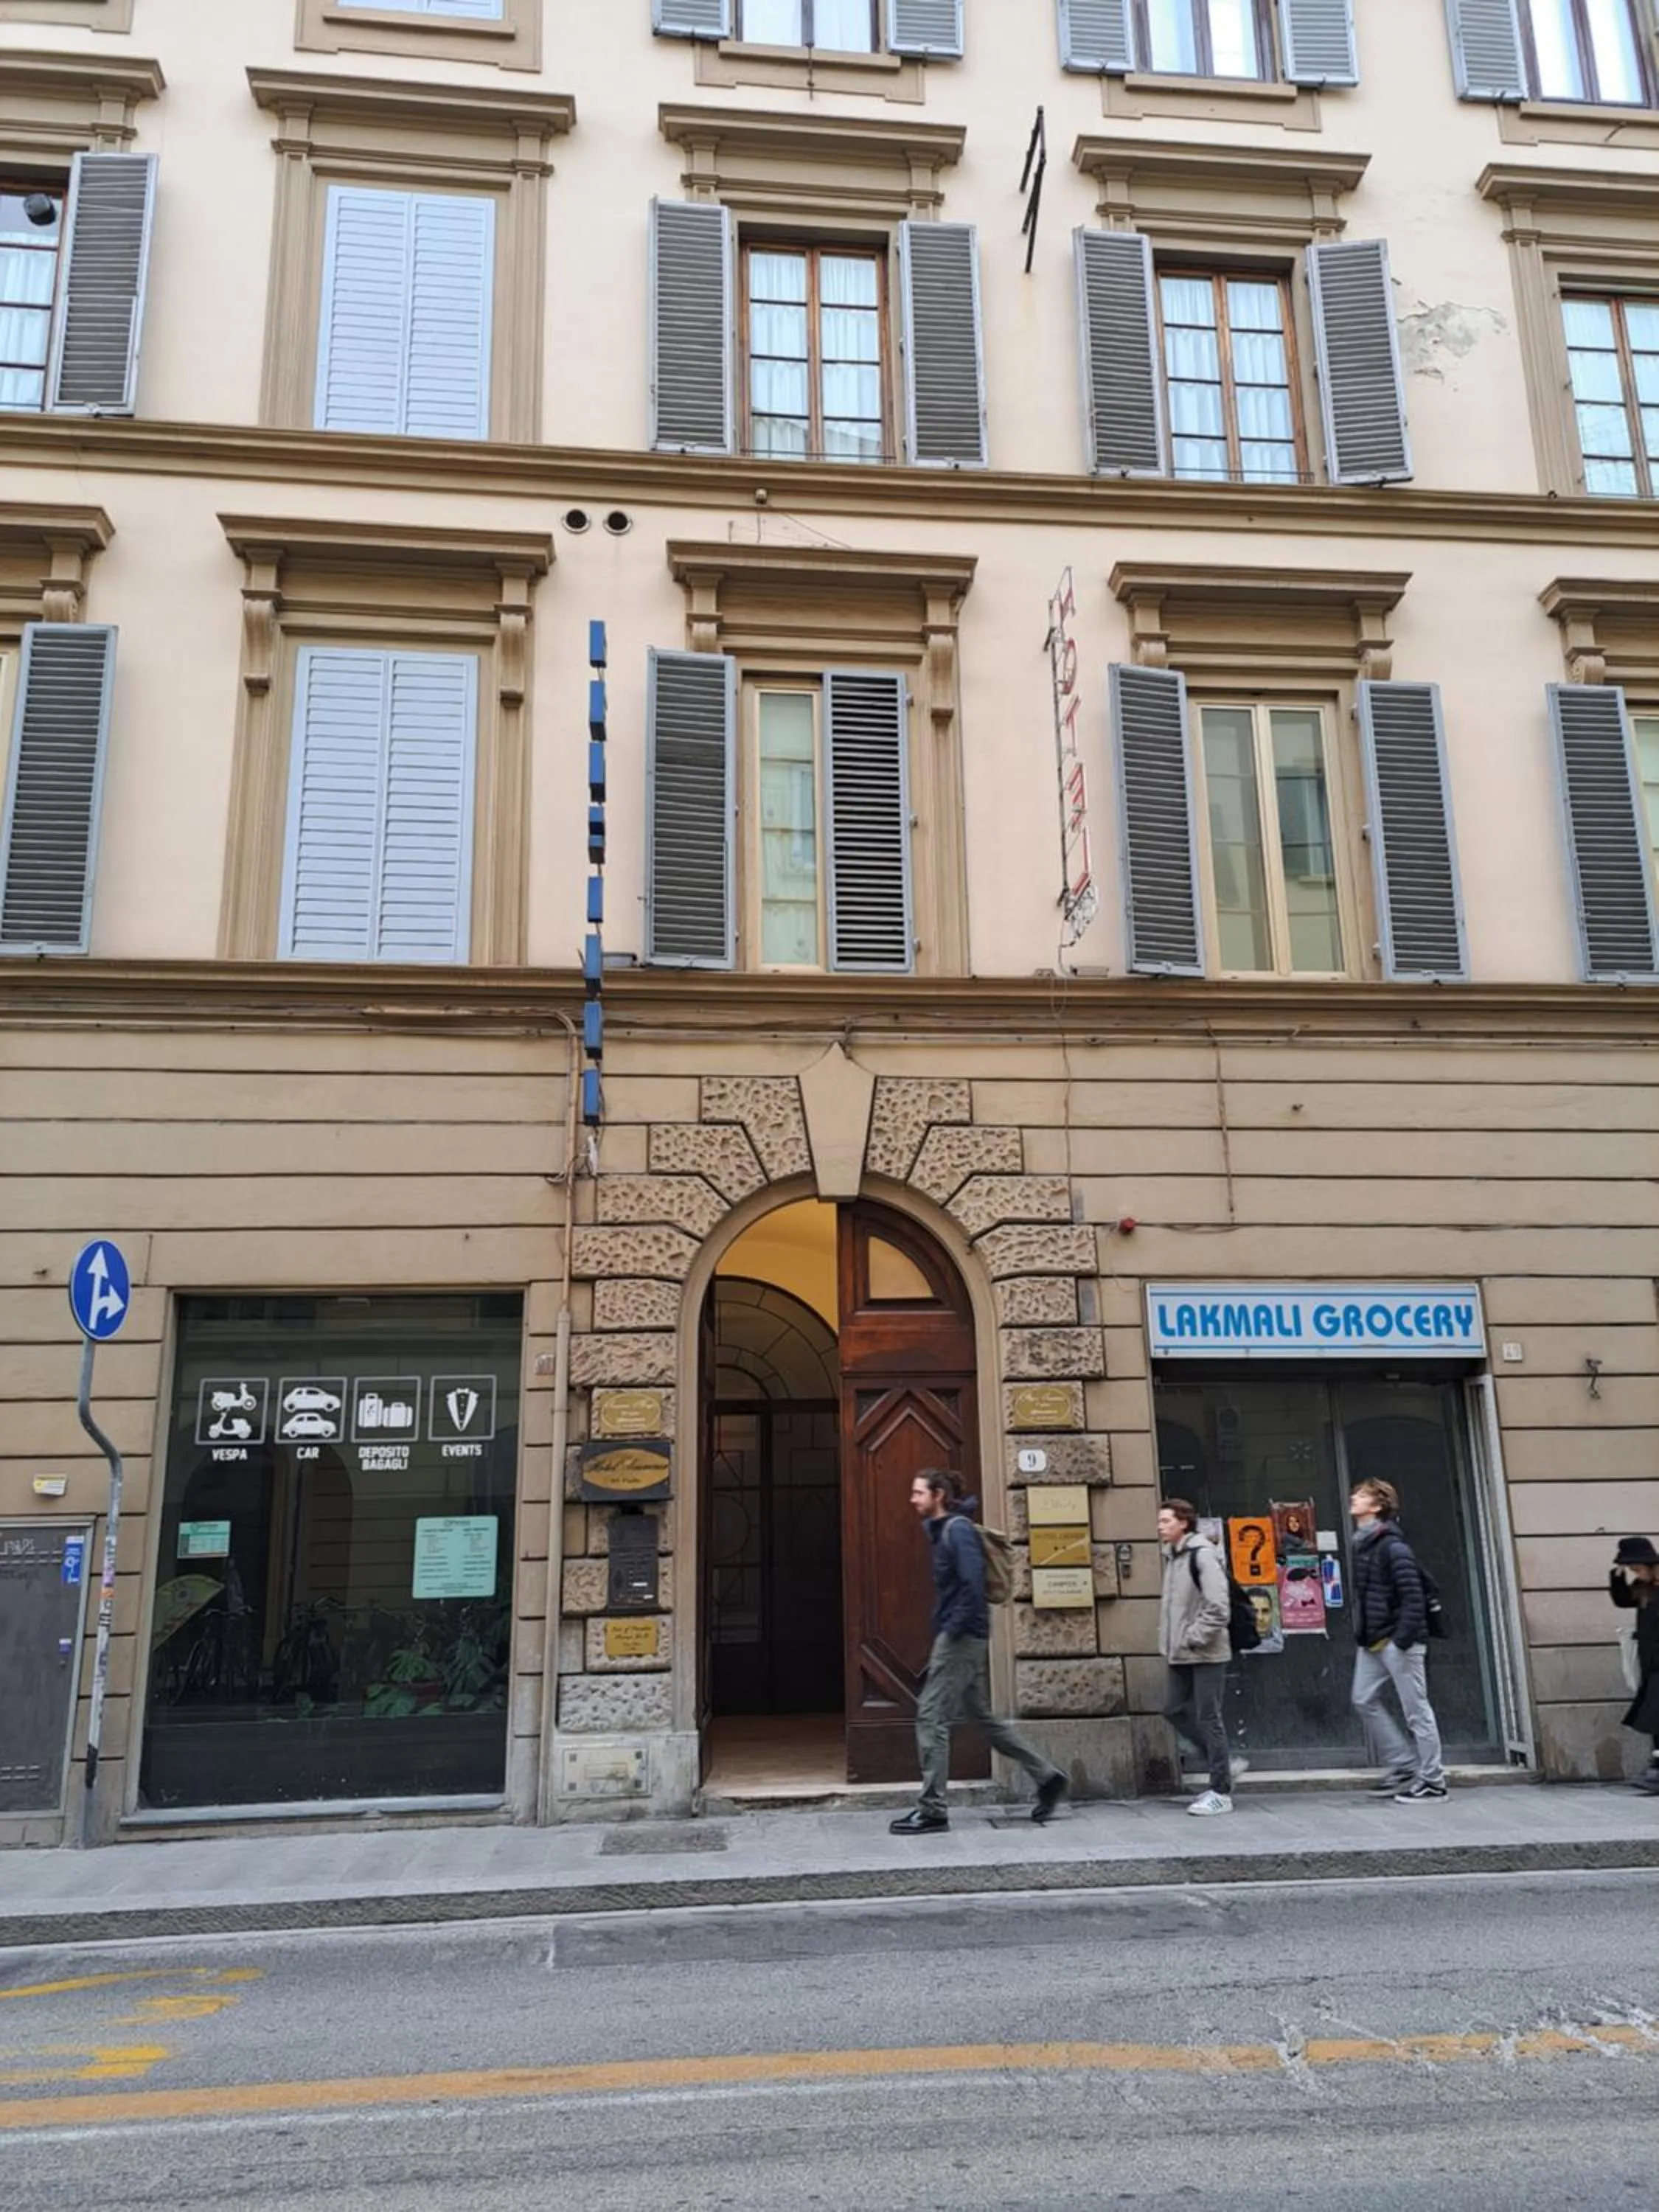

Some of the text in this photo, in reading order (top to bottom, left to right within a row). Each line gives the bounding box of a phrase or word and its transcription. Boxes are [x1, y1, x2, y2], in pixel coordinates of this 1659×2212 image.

[1158, 1304, 1473, 1338] LAKMALI GROCERY
[212, 1449, 248, 1461] VESPA
[296, 1447, 319, 1459] CAR
[358, 1446, 410, 1458] DEPOSITO
[442, 1444, 482, 1457] EVENTS
[362, 1458, 408, 1471] BAGAGLI
[1027, 1453, 1037, 1467] 9
